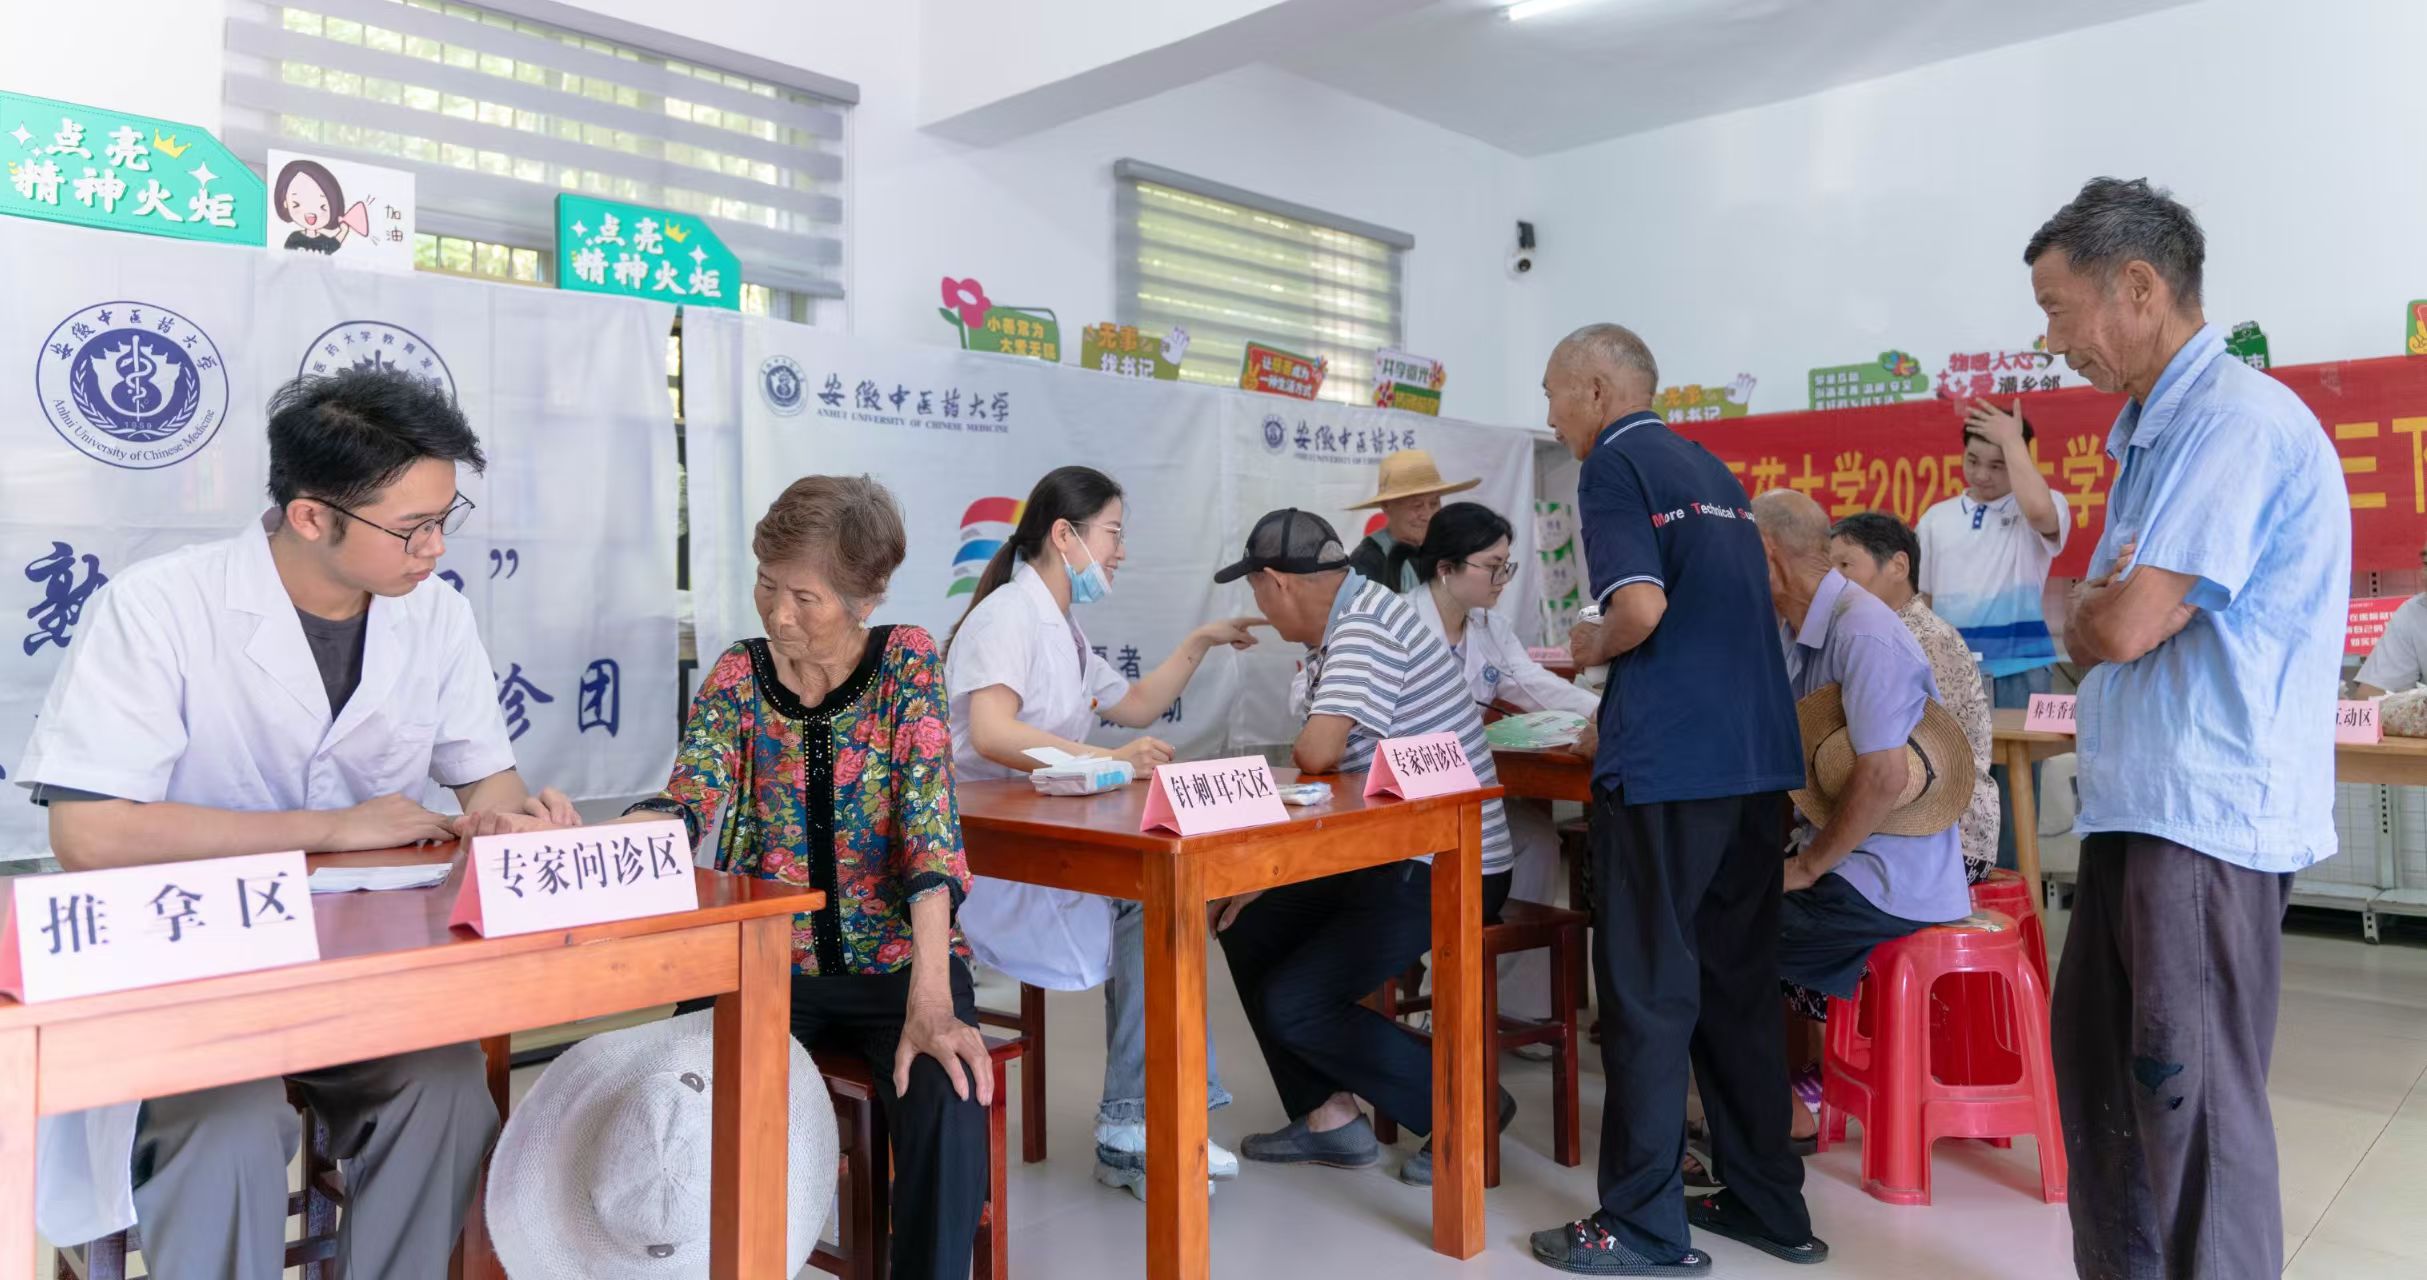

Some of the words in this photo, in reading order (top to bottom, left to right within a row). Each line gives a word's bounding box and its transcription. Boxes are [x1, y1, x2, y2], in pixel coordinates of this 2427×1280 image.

[45, 117, 151, 172] 点亮
[11, 158, 237, 229] 精神火炬
[593, 212, 664, 255] 点亮
[572, 247, 721, 298] 精神火炬
[817, 373, 1009, 422] 安徽中医药大学
[817, 408, 848, 421] ANHUI
[852, 412, 906, 427] UNIVERSITY
[53, 399, 79, 429] Anhui
[74, 426, 128, 461] University
[130, 450, 143, 461] of
[143, 442, 184, 461] Chinese
[182, 408, 215, 447] Medicine
[1294, 419, 1416, 454] 安徽中医药大学
[1652, 508, 1685, 528] More
[1690, 502, 1736, 519] Technical
[1391, 741, 1466, 776] 专家问诊区
[1170, 766, 1273, 808] 针刺耳穴区
[492, 833, 683, 898] 专家问诊区
[40, 872, 296, 954] 推拿区
